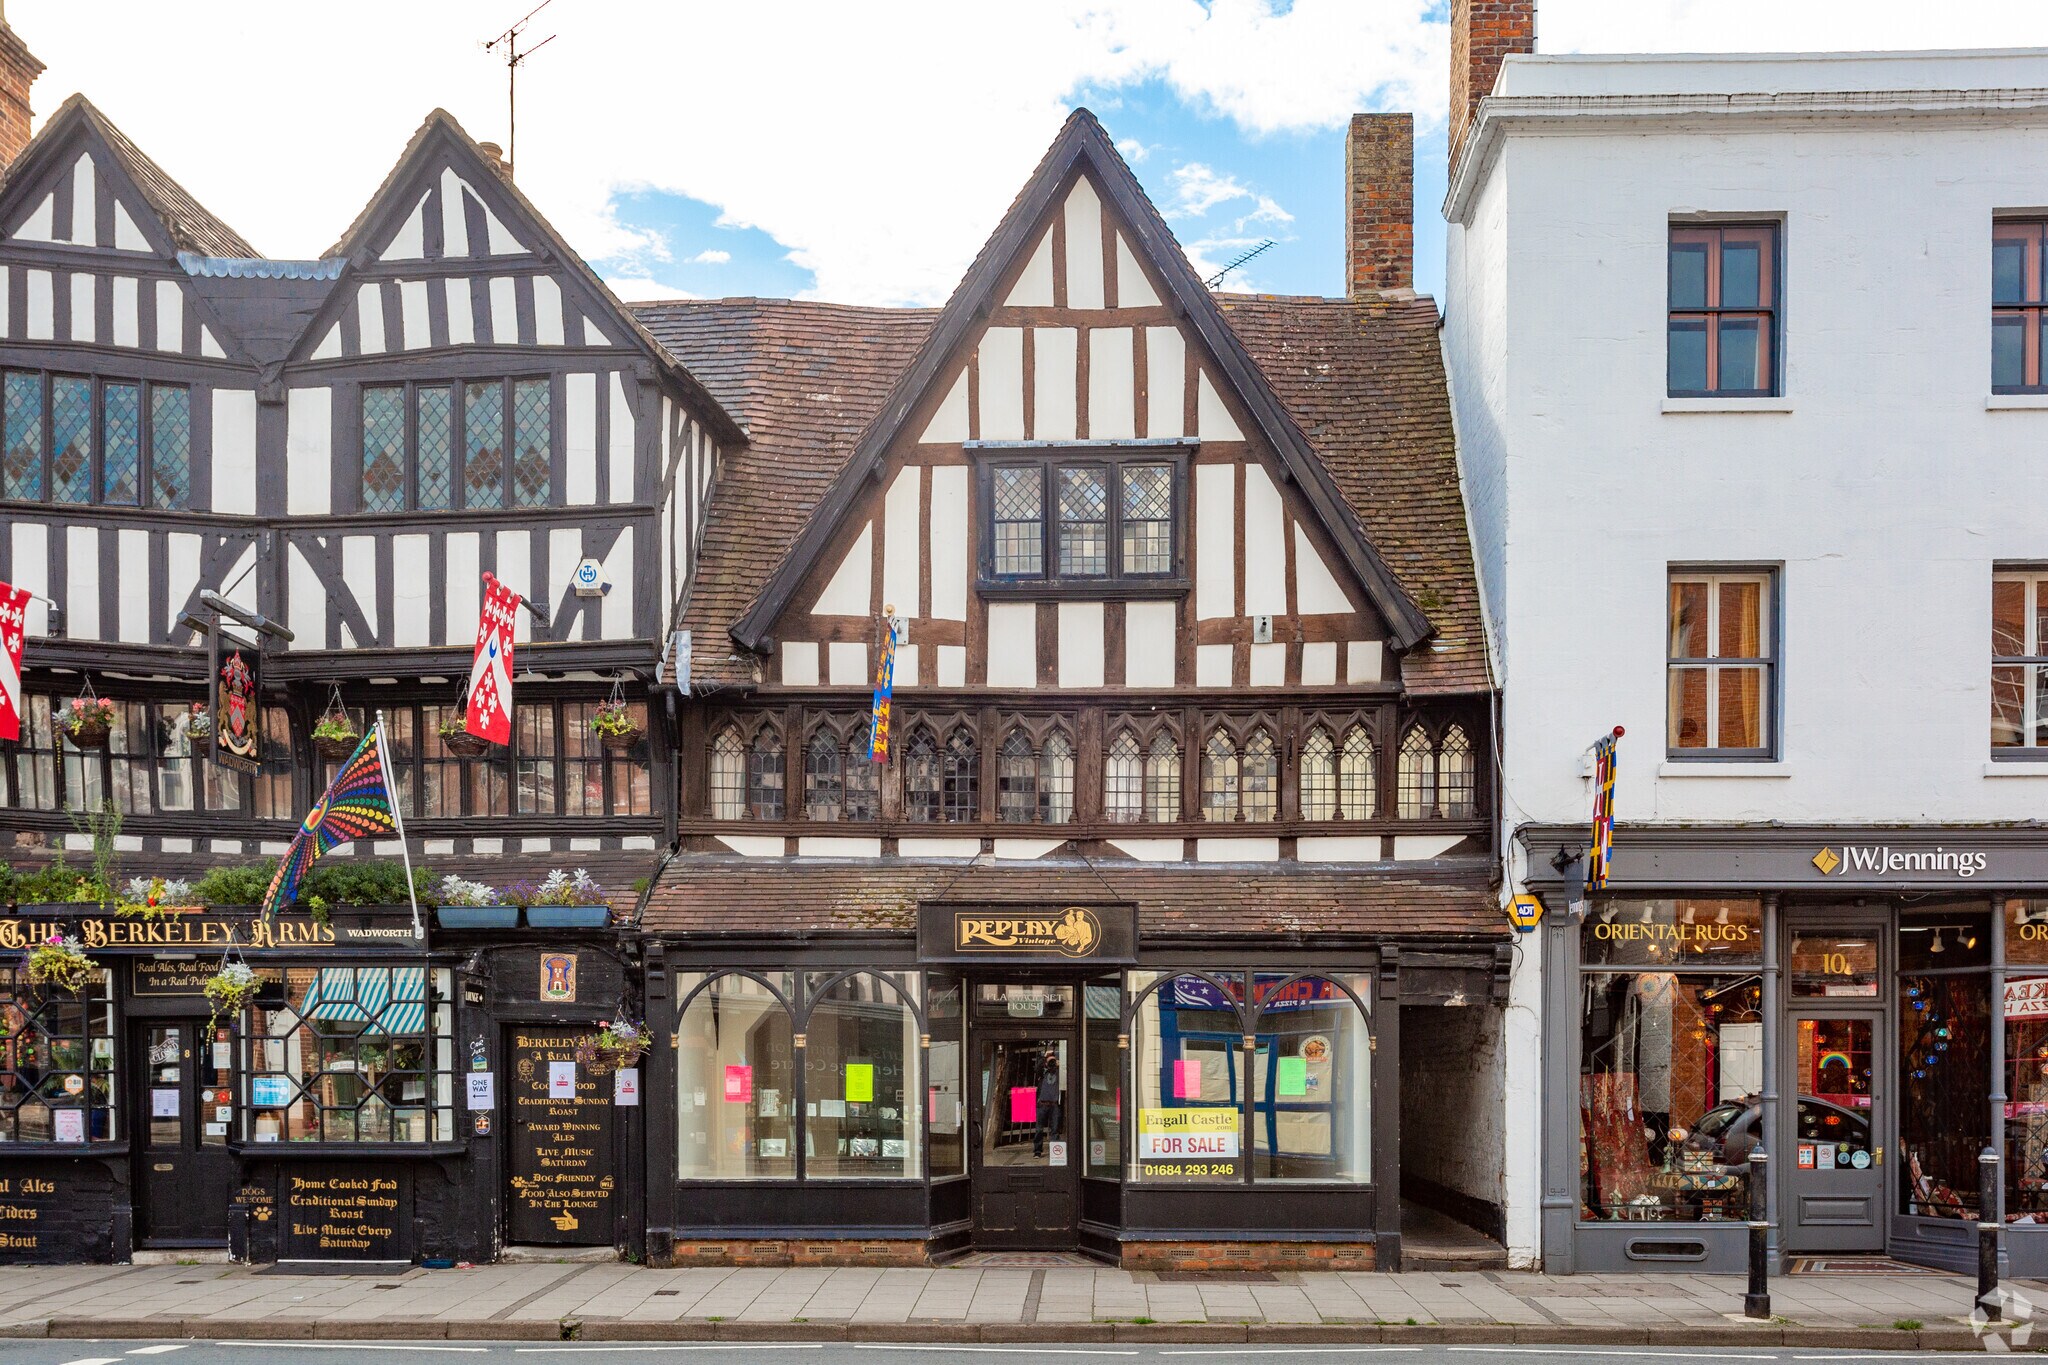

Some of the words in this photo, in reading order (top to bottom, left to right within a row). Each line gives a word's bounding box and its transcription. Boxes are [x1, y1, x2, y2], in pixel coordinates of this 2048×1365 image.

[1517, 906, 1534, 916] ADT
[82, 919, 239, 948] BERKELEY
[249, 919, 335, 948] ARMS
[347, 929, 412, 938] WADWORTH
[961, 920, 1058, 946] REPLAY
[1595, 923, 1691, 940] ORIENTAL
[1695, 924, 1748, 940] RUGS
[1018, 937, 1056, 945] Vintage
[136, 961, 157, 973] Real
[157, 961, 176, 974] Ales,
[177, 961, 198, 972] Real
[198, 961, 220, 973] Food
[1823, 953, 1846, 973] 10
[149, 977, 160, 987] In
[168, 974, 189, 986] Real
[986, 993, 1064, 1002] PLATAGENET
[516, 1035, 576, 1049] BERKELEY
[184, 1049, 191, 1058] 8
[547, 1051, 573, 1061] REAL
[518, 1096, 571, 1106] TRADITIONAL
[573, 1096, 610, 1106] SUNDAY
[549, 1107, 579, 1116] ROAST
[1146, 1114, 1187, 1127] Engall
[1191, 1114, 1232, 1125] Castle
[527, 1123, 560, 1132] AWARD
[562, 1123, 601, 1131] WINNING
[552, 1133, 575, 1143] ALES
[1152, 1138, 1182, 1153] FOR
[1188, 1138, 1226, 1153] SALE
[535, 1147, 559, 1157] LIVE
[561, 1148, 594, 1159] MUSIC
[541, 1158, 587, 1167] SATURDAY
[1145, 1165, 1182, 1176] 01684
[1185, 1165, 1208, 1176] 293
[1211, 1164, 1234, 1175] 246
[532, 1173, 554, 1182] DOG
[555, 1173, 597, 1183] FRIENDLY
[20, 1178, 55, 1196] Ales
[290, 1177, 326, 1191] Home
[329, 1178, 368, 1190] Cooked
[370, 1178, 397, 1192] Food
[241, 1188, 266, 1196] DOGS
[519, 1188, 545, 1198] FOOD
[546, 1189, 571, 1199] ALSO
[571, 1188, 609, 1198] SERVED
[290, 1195, 355, 1207] Traditional
[356, 1195, 398, 1211] Sunday
[529, 1200, 542, 1208] IN
[563, 1199, 598, 1208] LOUNGE
[329, 1208, 364, 1219] Roast
[293, 1223, 318, 1235] Live
[321, 1224, 356, 1237] Music
[357, 1224, 392, 1239] Every
[319, 1237, 371, 1251] Saturday
